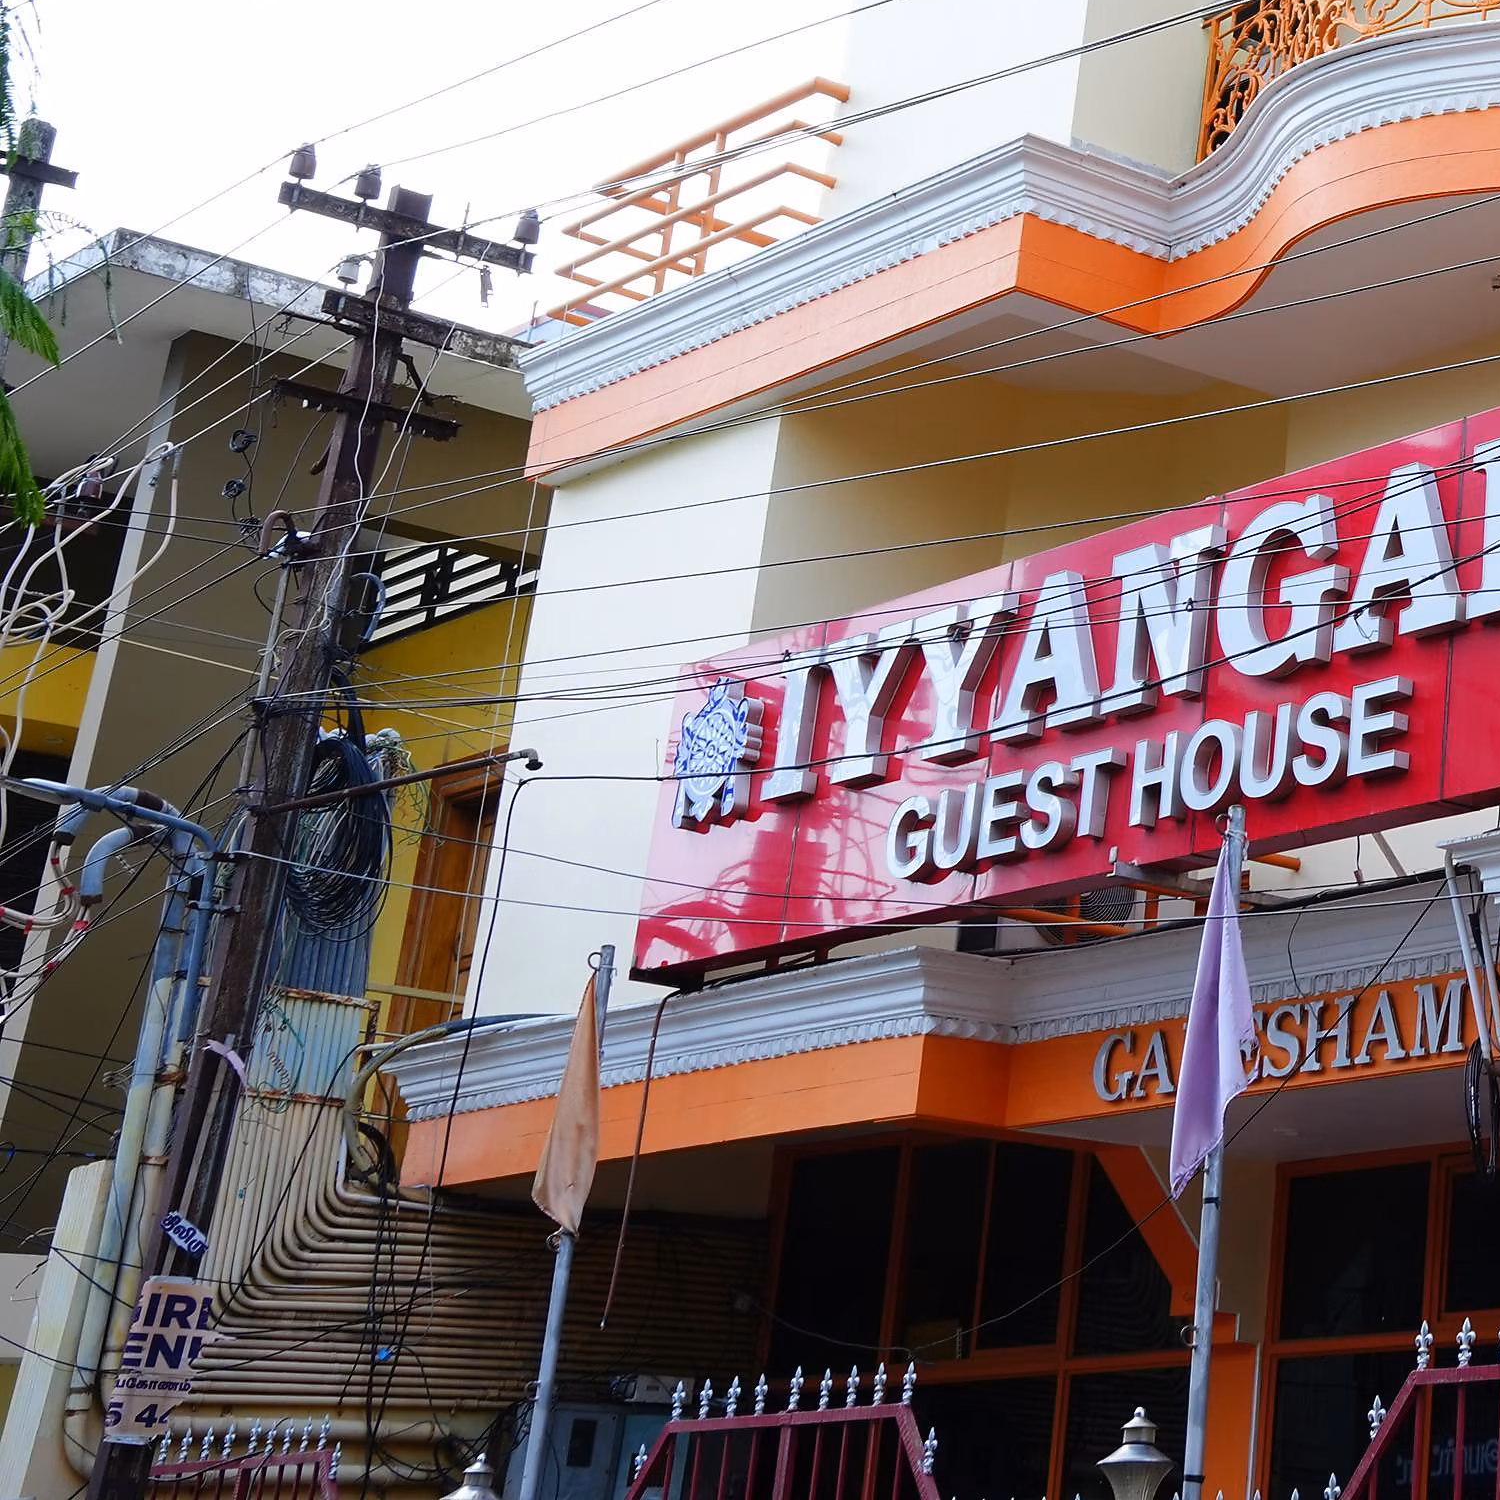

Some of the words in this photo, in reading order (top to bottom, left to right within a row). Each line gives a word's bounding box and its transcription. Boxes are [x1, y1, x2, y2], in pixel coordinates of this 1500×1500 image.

[887, 747, 1124, 883] GUEST
[1129, 677, 1413, 828] HOUSE
[1092, 978, 1468, 1104] GASHAM
